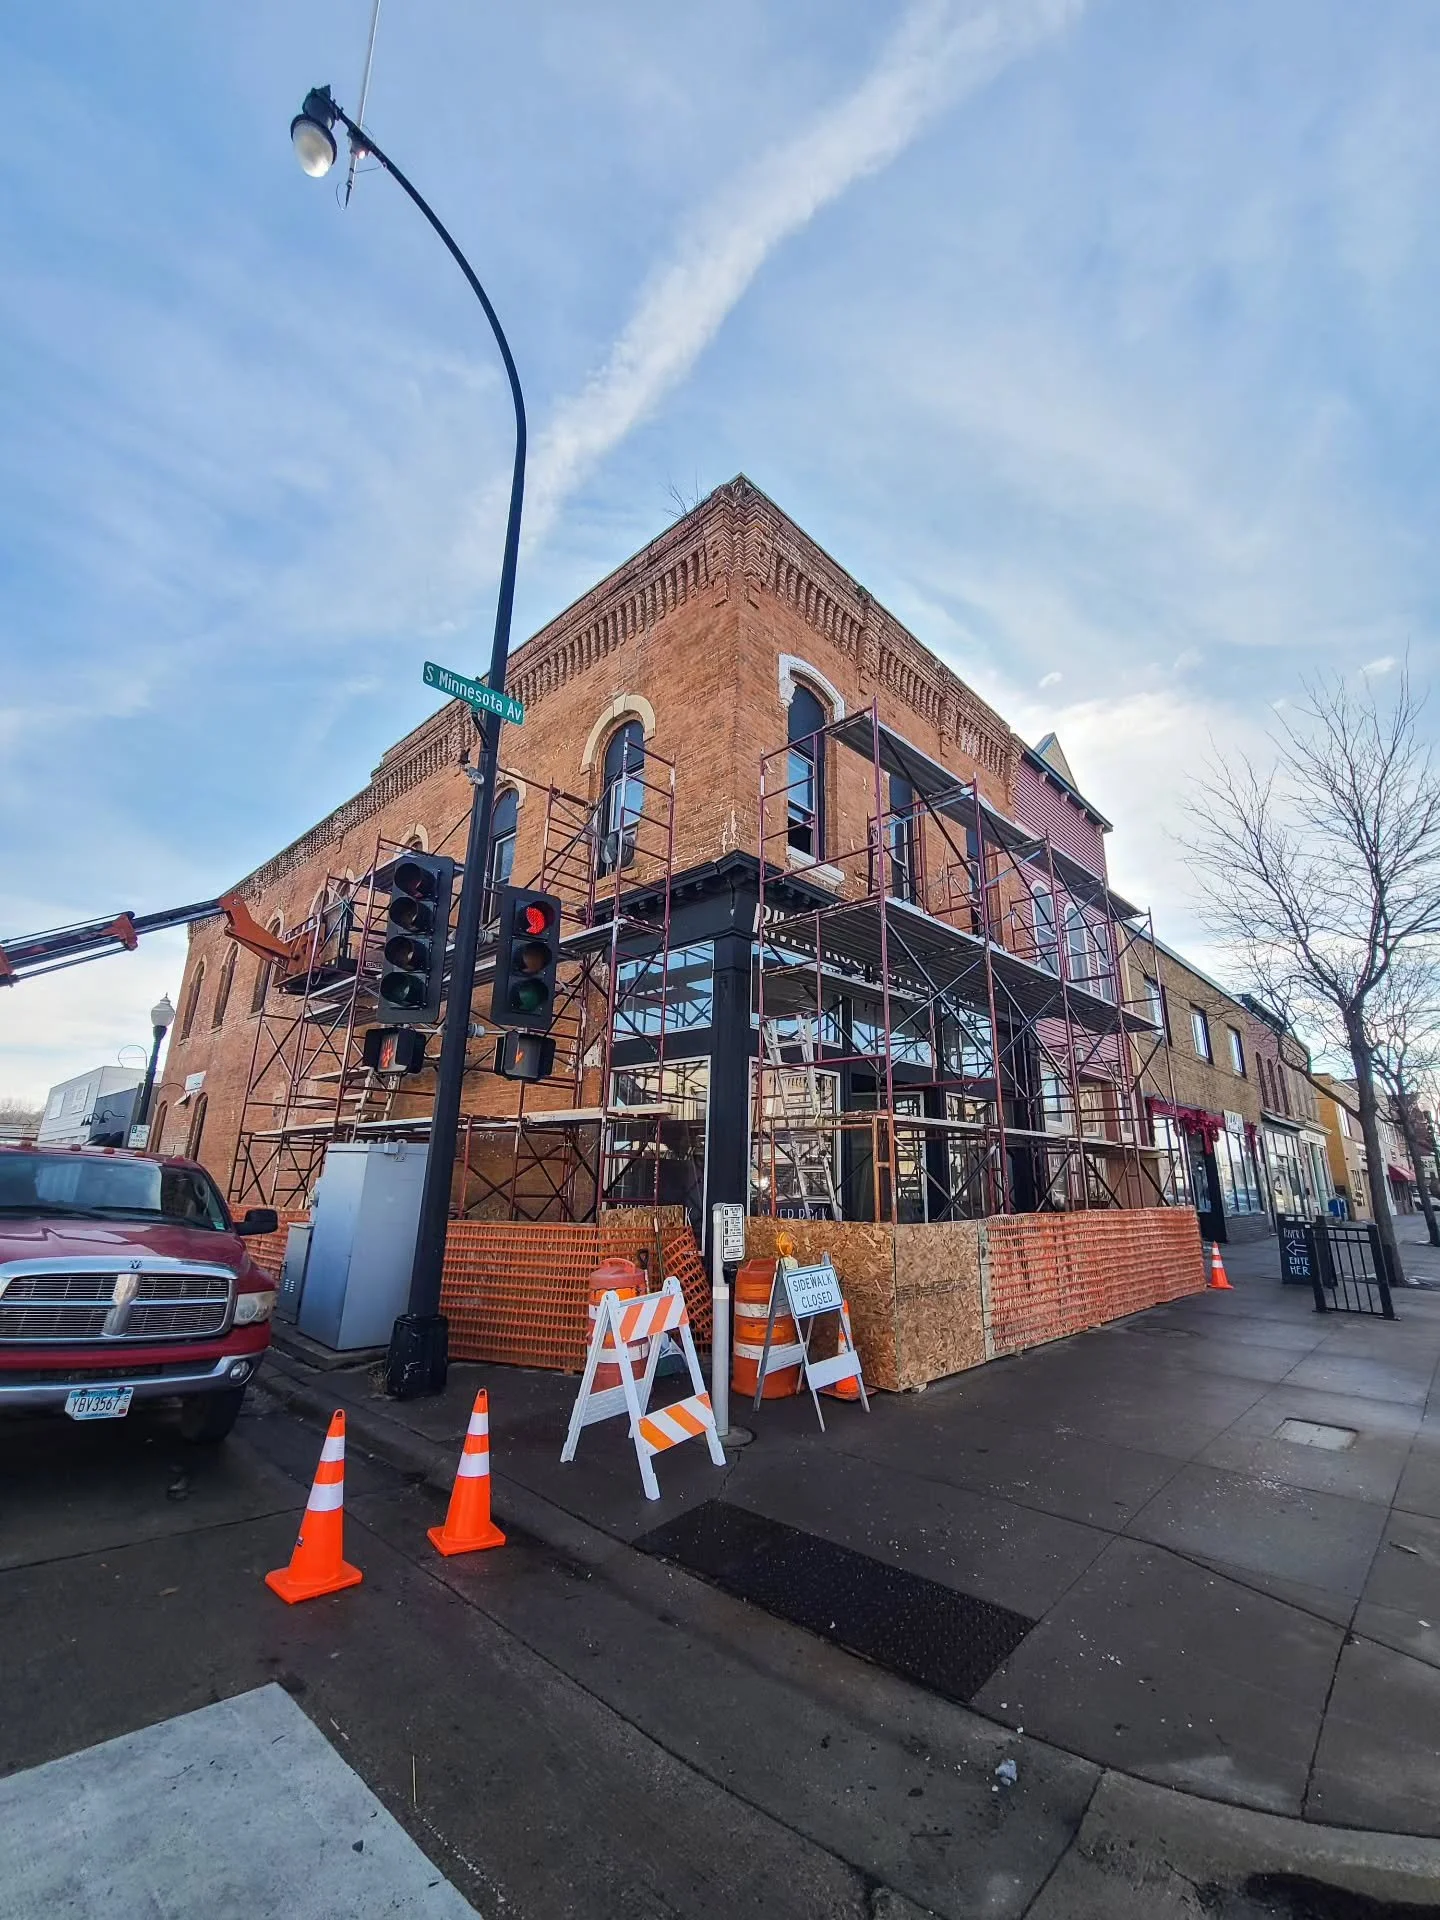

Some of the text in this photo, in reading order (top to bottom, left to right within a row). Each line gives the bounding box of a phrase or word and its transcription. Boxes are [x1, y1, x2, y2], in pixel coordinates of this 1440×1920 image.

[425, 665, 522, 721] S Minnesota Av
[1289, 1256, 1310, 1266] ENTE
[1290, 1265, 1311, 1276] HER
[792, 1273, 833, 1292] SIDEWALK
[801, 1290, 833, 1309] CLOSED
[72, 1395, 121, 1413] YBV3567
